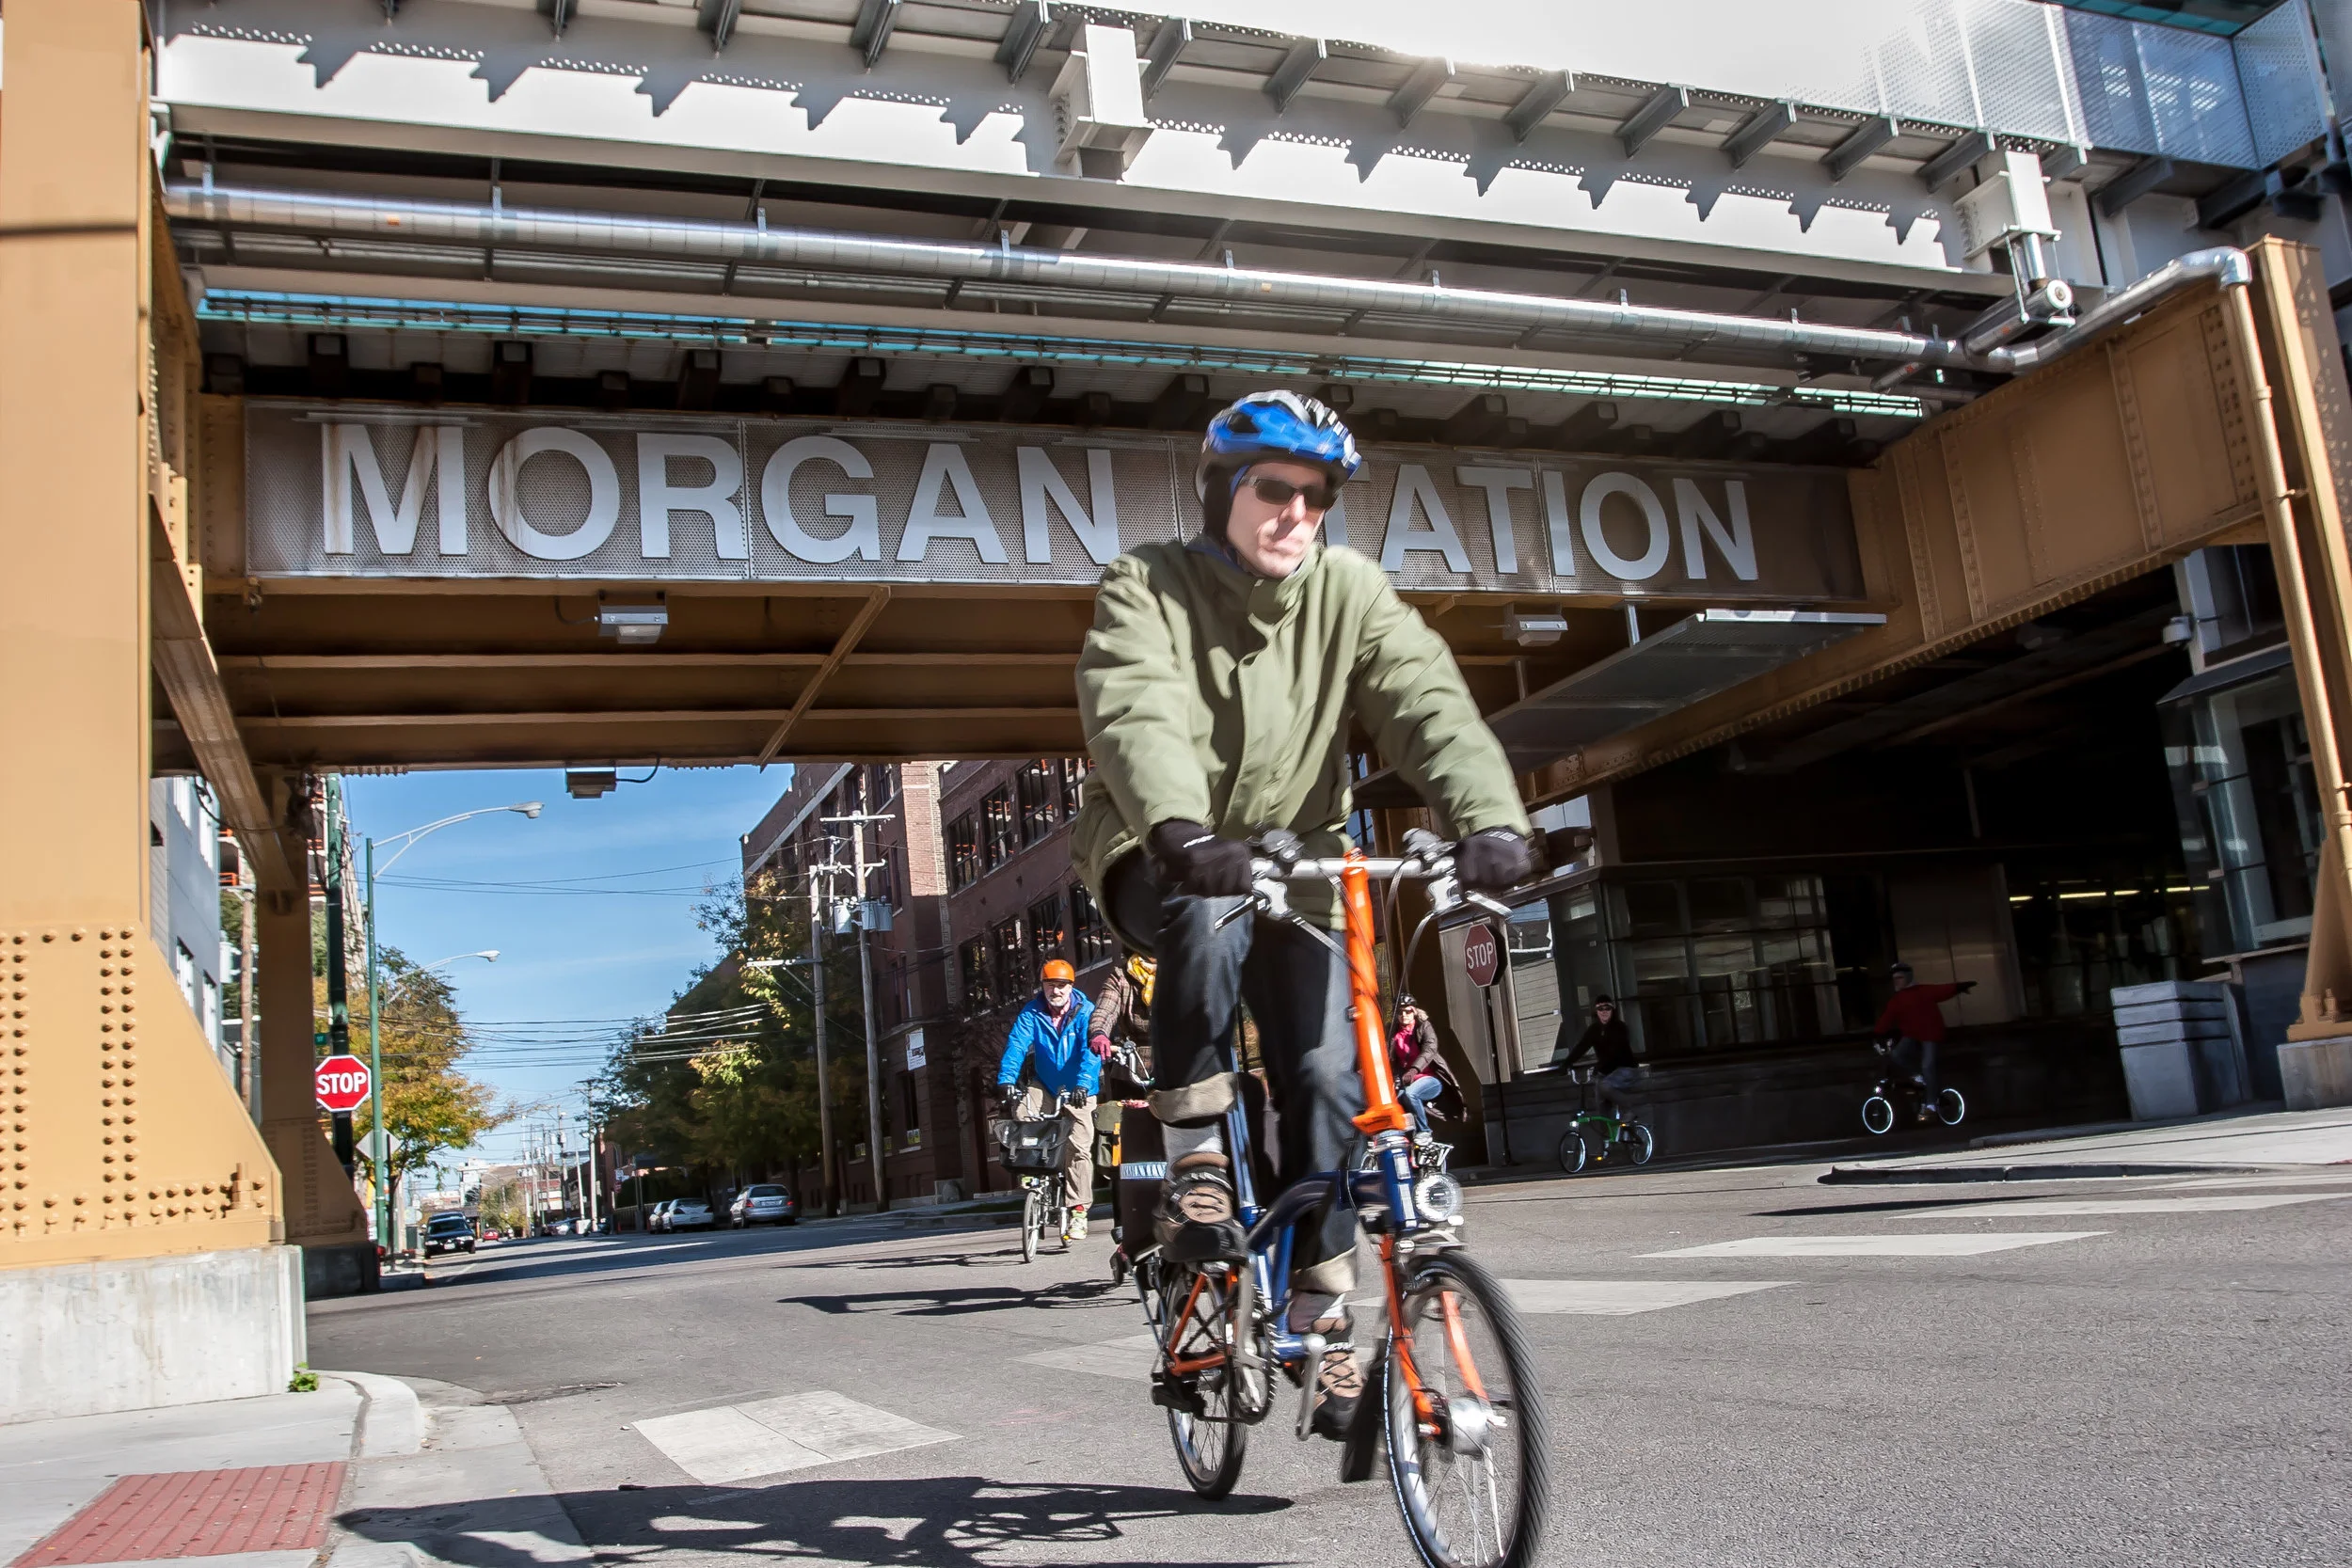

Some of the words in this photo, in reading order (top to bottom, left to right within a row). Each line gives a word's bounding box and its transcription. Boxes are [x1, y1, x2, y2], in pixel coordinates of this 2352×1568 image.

[322, 423, 1119, 566] MORGAN
[1196, 461, 1758, 581] ATION
[1466, 942, 1493, 970] STOP
[316, 1071, 367, 1095] STOP
